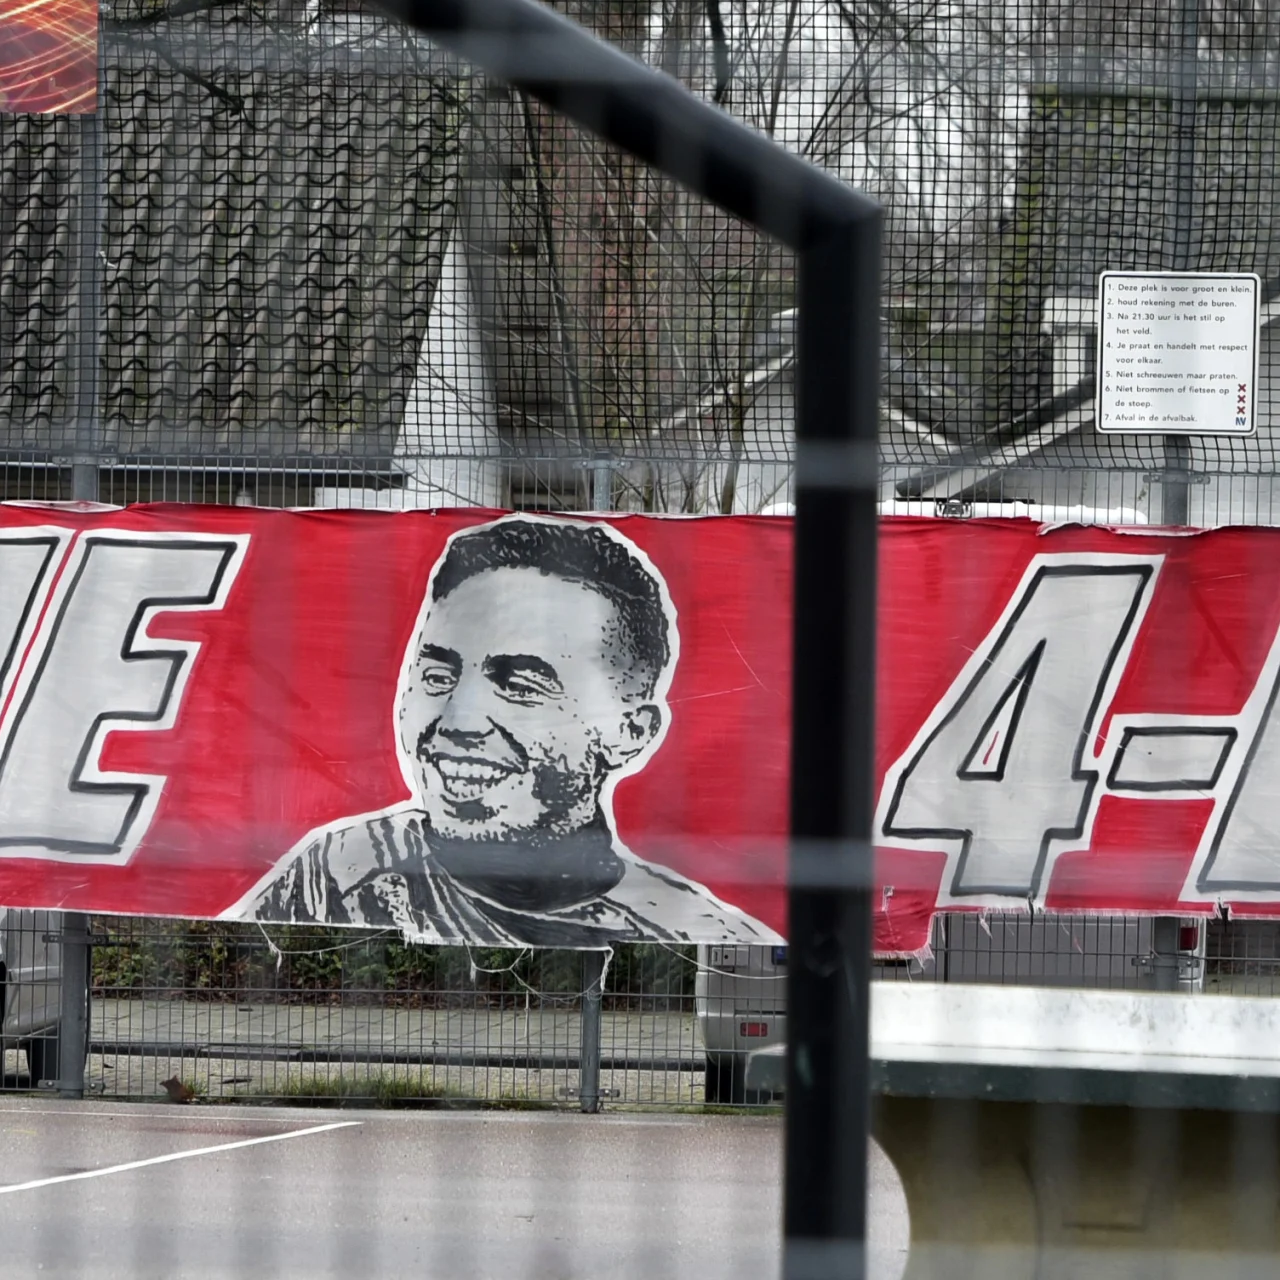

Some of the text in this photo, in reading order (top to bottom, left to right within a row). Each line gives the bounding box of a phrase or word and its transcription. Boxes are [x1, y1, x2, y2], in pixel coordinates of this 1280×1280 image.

[1118, 283, 1138, 291] Deze
[1141, 284, 1158, 293] plek
[1192, 286, 1214, 294] groot
[1230, 285, 1252, 293] klein.
[1117, 298, 1138, 306] houd
[1141, 299, 1176, 308] rekening
[1197, 299, 1209, 307] de
[1211, 299, 1237, 307] buren.
[1132, 313, 1155, 321] 21.30
[1174, 313, 1180, 321] is
[1183, 314, 1197, 322] het
[1199, 314, 1212, 322] stil
[1116, 327, 1152, 335] het veld.
[1129, 342, 1151, 351] praat
[1166, 342, 1197, 351] handelt
[1218, 344, 1248, 352] respect
[1137, 356, 1163, 365] elkaar.
[1116, 370, 1134, 378] Niet
[1136, 371, 1184, 379] schreeuwen
[1209, 373, 1238, 381] praten.
[1115, 385, 1133, 393] Niet
[1136, 385, 1175, 394] brommen
[1177, 386, 1186, 394] of
[1188, 386, 1216, 394] fietsen
[1218, 388, 1230, 396] op
[1114, 399, 1153, 409] de stoep.
[1114, 413, 1136, 421] Afval
[1148, 414, 1159, 422] de
[1162, 414, 1198, 423] afvalbak.
